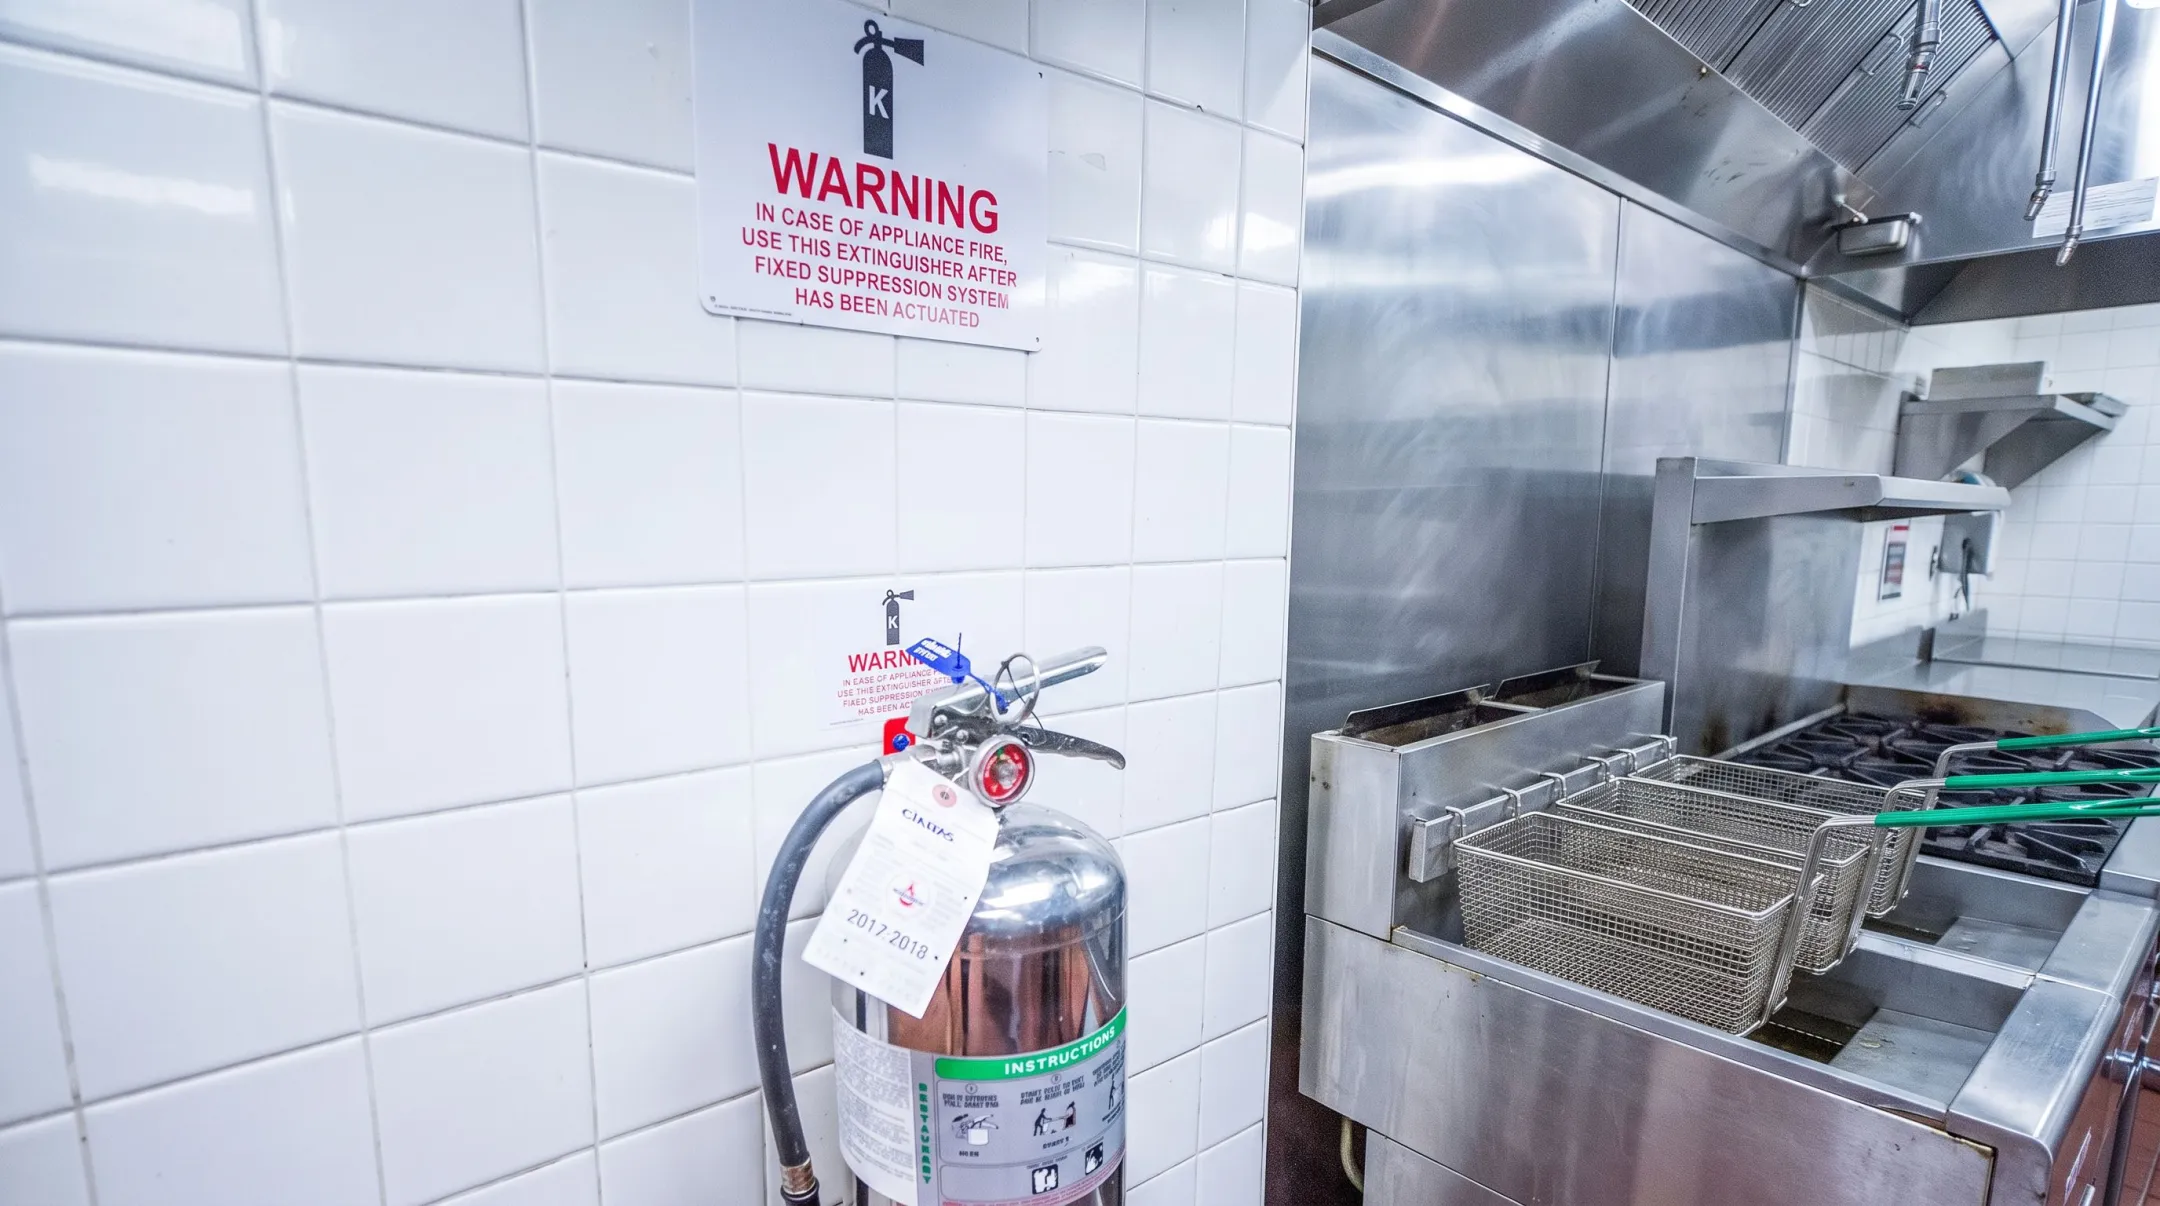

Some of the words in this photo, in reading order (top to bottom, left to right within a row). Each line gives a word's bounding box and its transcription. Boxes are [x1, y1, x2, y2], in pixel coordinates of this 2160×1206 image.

[868, 85, 890, 120] K
[768, 142, 999, 235] WARNING
[756, 202, 775, 223] IN
[782, 207, 834, 232] CASE
[839, 218, 864, 237] OF
[869, 224, 965, 257] APPLIANCE
[969, 241, 1008, 266] FIRE,
[742, 227, 783, 250] USE
[788, 234, 831, 258] THIS
[837, 242, 964, 279] EXTINGUISHER
[967, 267, 1017, 288] AFTER
[755, 256, 812, 281] FIXED
[817, 266, 942, 300] SUPPRESSION
[947, 285, 1009, 310] SYSTEM
[795, 287, 835, 310] HAS
[840, 294, 889, 317] BEEN
[892, 302, 980, 328] ACTUATED
[888, 615, 898, 630] K
[842, 679, 851, 687] IN
[889, 668, 932, 681] APPLIANCE
[848, 650, 924, 673] WARN
[837, 689, 854, 698] USE
[857, 686, 874, 696] THIS
[876, 679, 932, 693] EXTINGUISHER
[869, 690, 923, 704] SUPPRESSION
[877, 703, 898, 713] BEEN
[1004, 1025, 1117, 1076] INSTRUCTIONS
